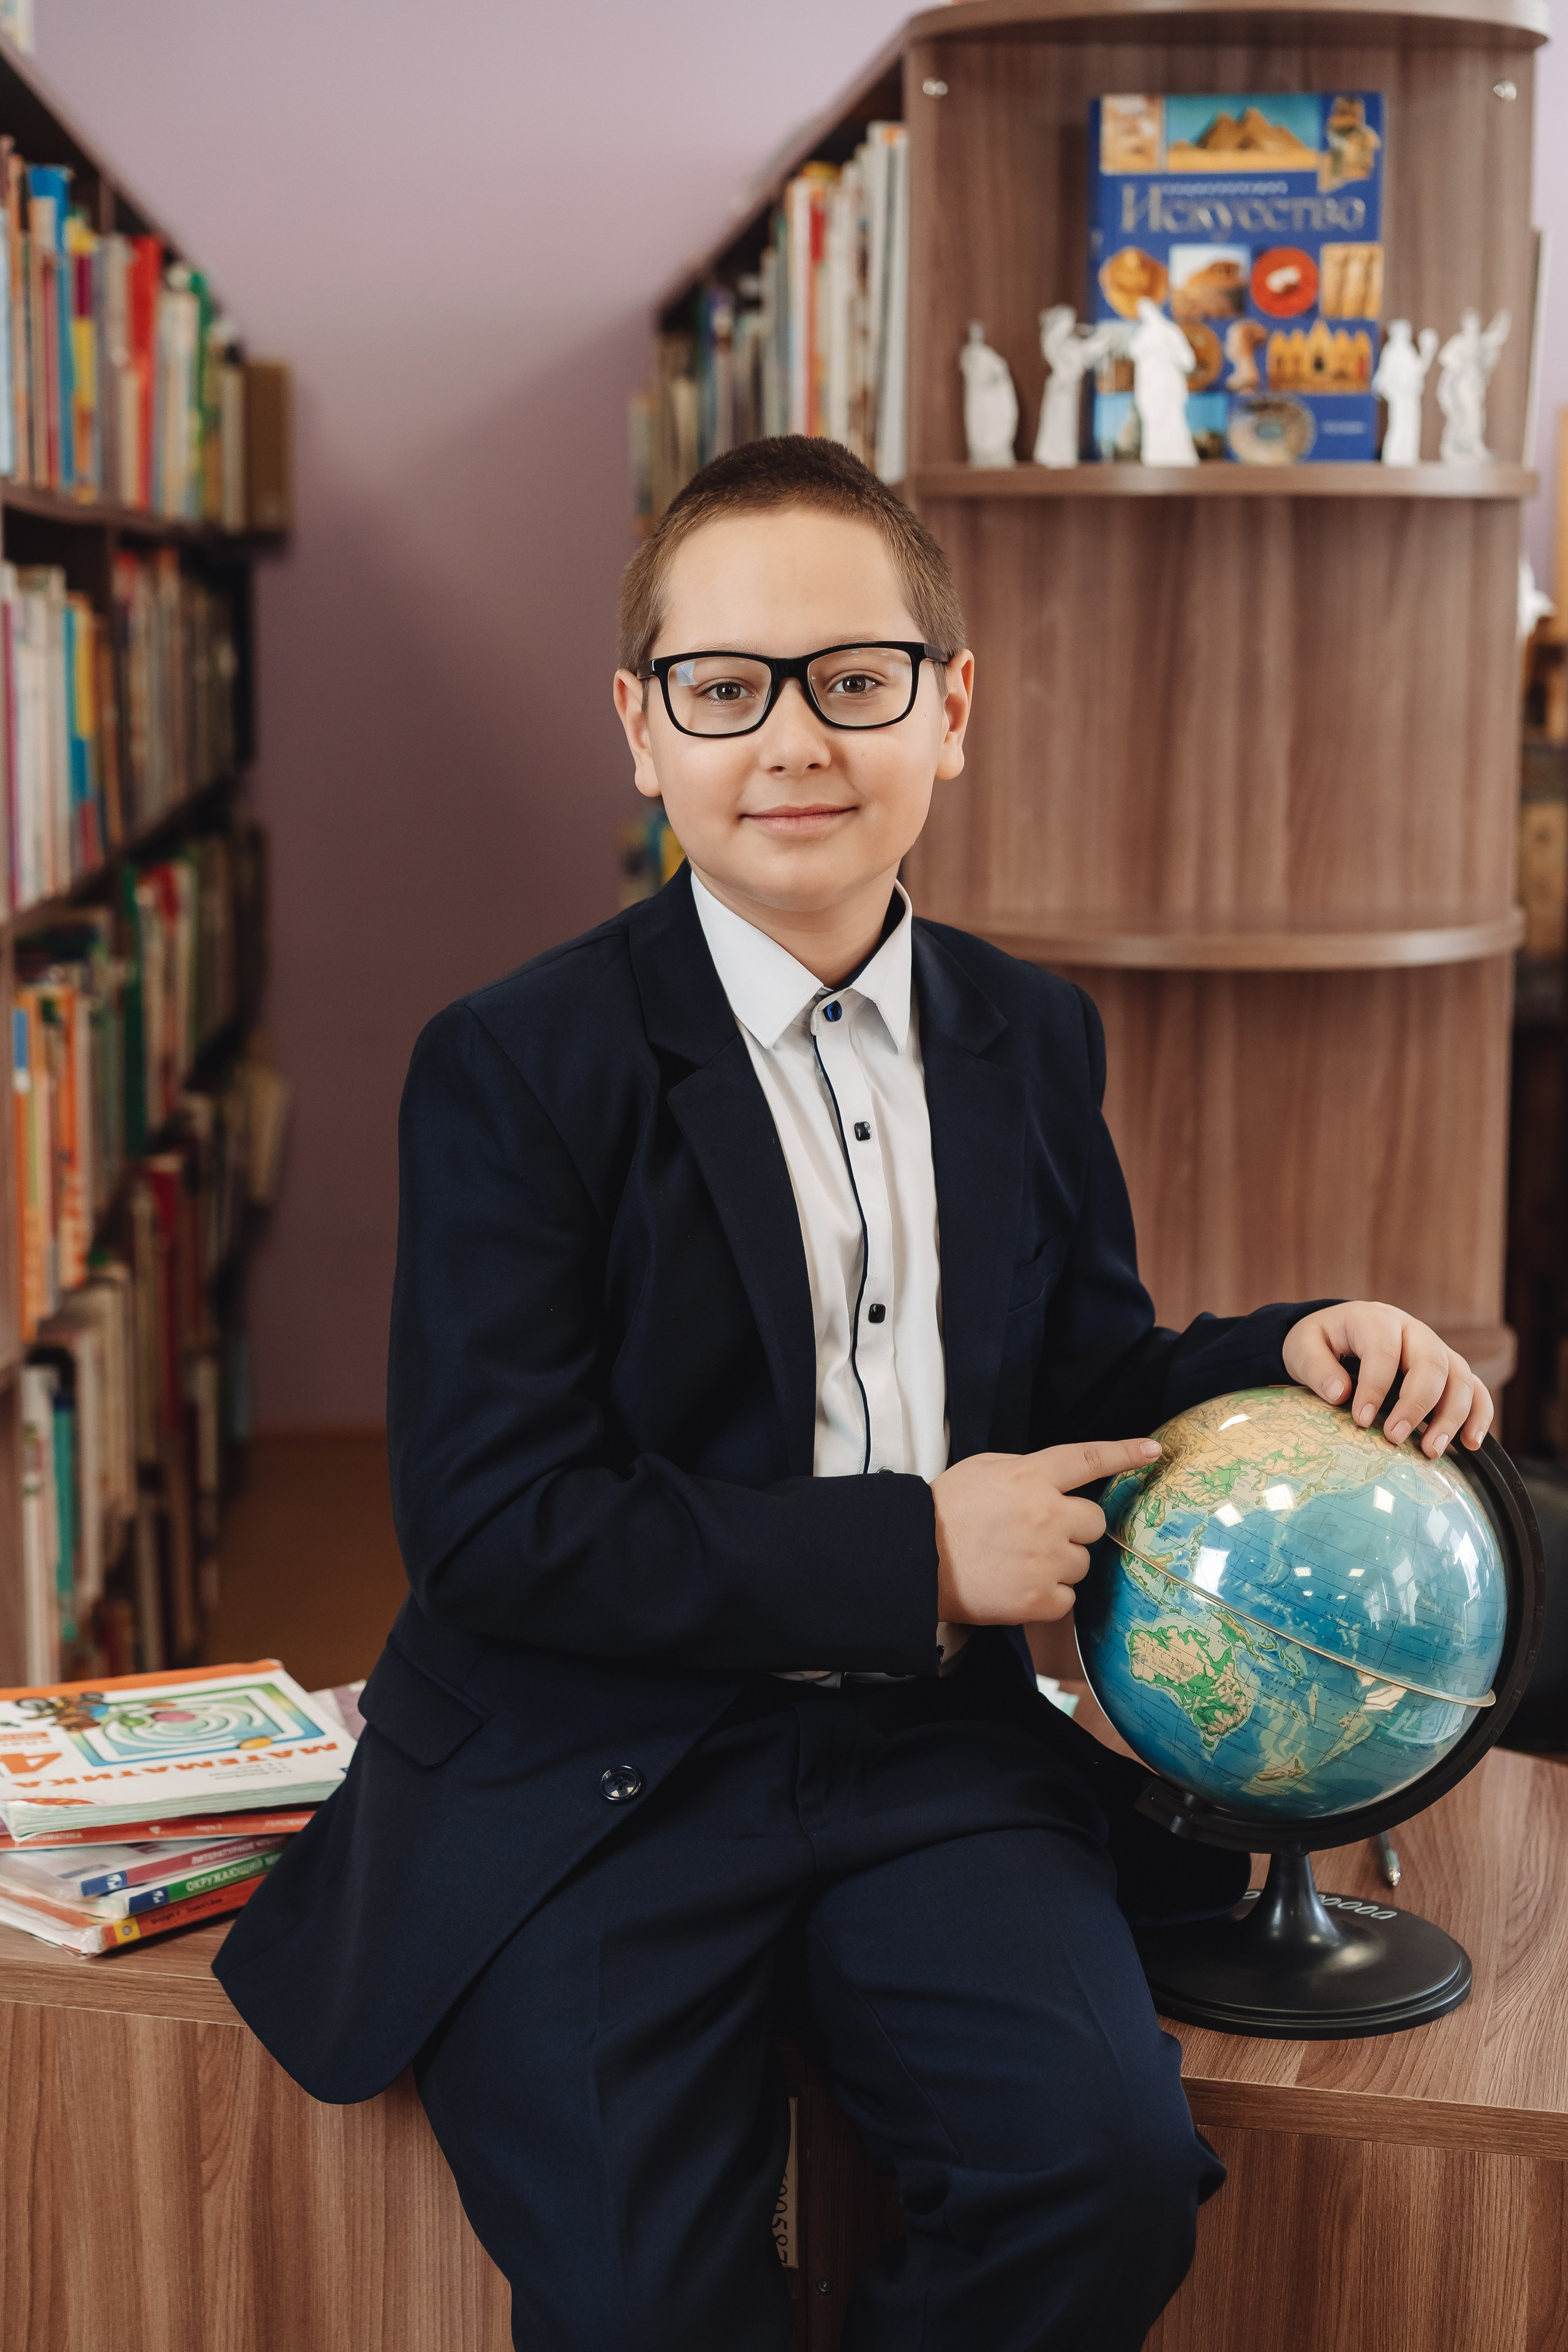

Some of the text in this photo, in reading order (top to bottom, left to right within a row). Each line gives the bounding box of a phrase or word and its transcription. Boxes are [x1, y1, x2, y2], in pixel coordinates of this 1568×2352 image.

[1121, 184, 1366, 243] Искусство
[1251, 1668, 1297, 1692] КОРАЛЛОВОЕ
[1260, 1682, 1278, 1694] МОРЕ
[0, 1752, 62, 1774] 4
[12, 1743, 337, 1787] МАТЕМАТИКА
[185, 1856, 263, 1891] ОКРУЖАЮЩИЙ
